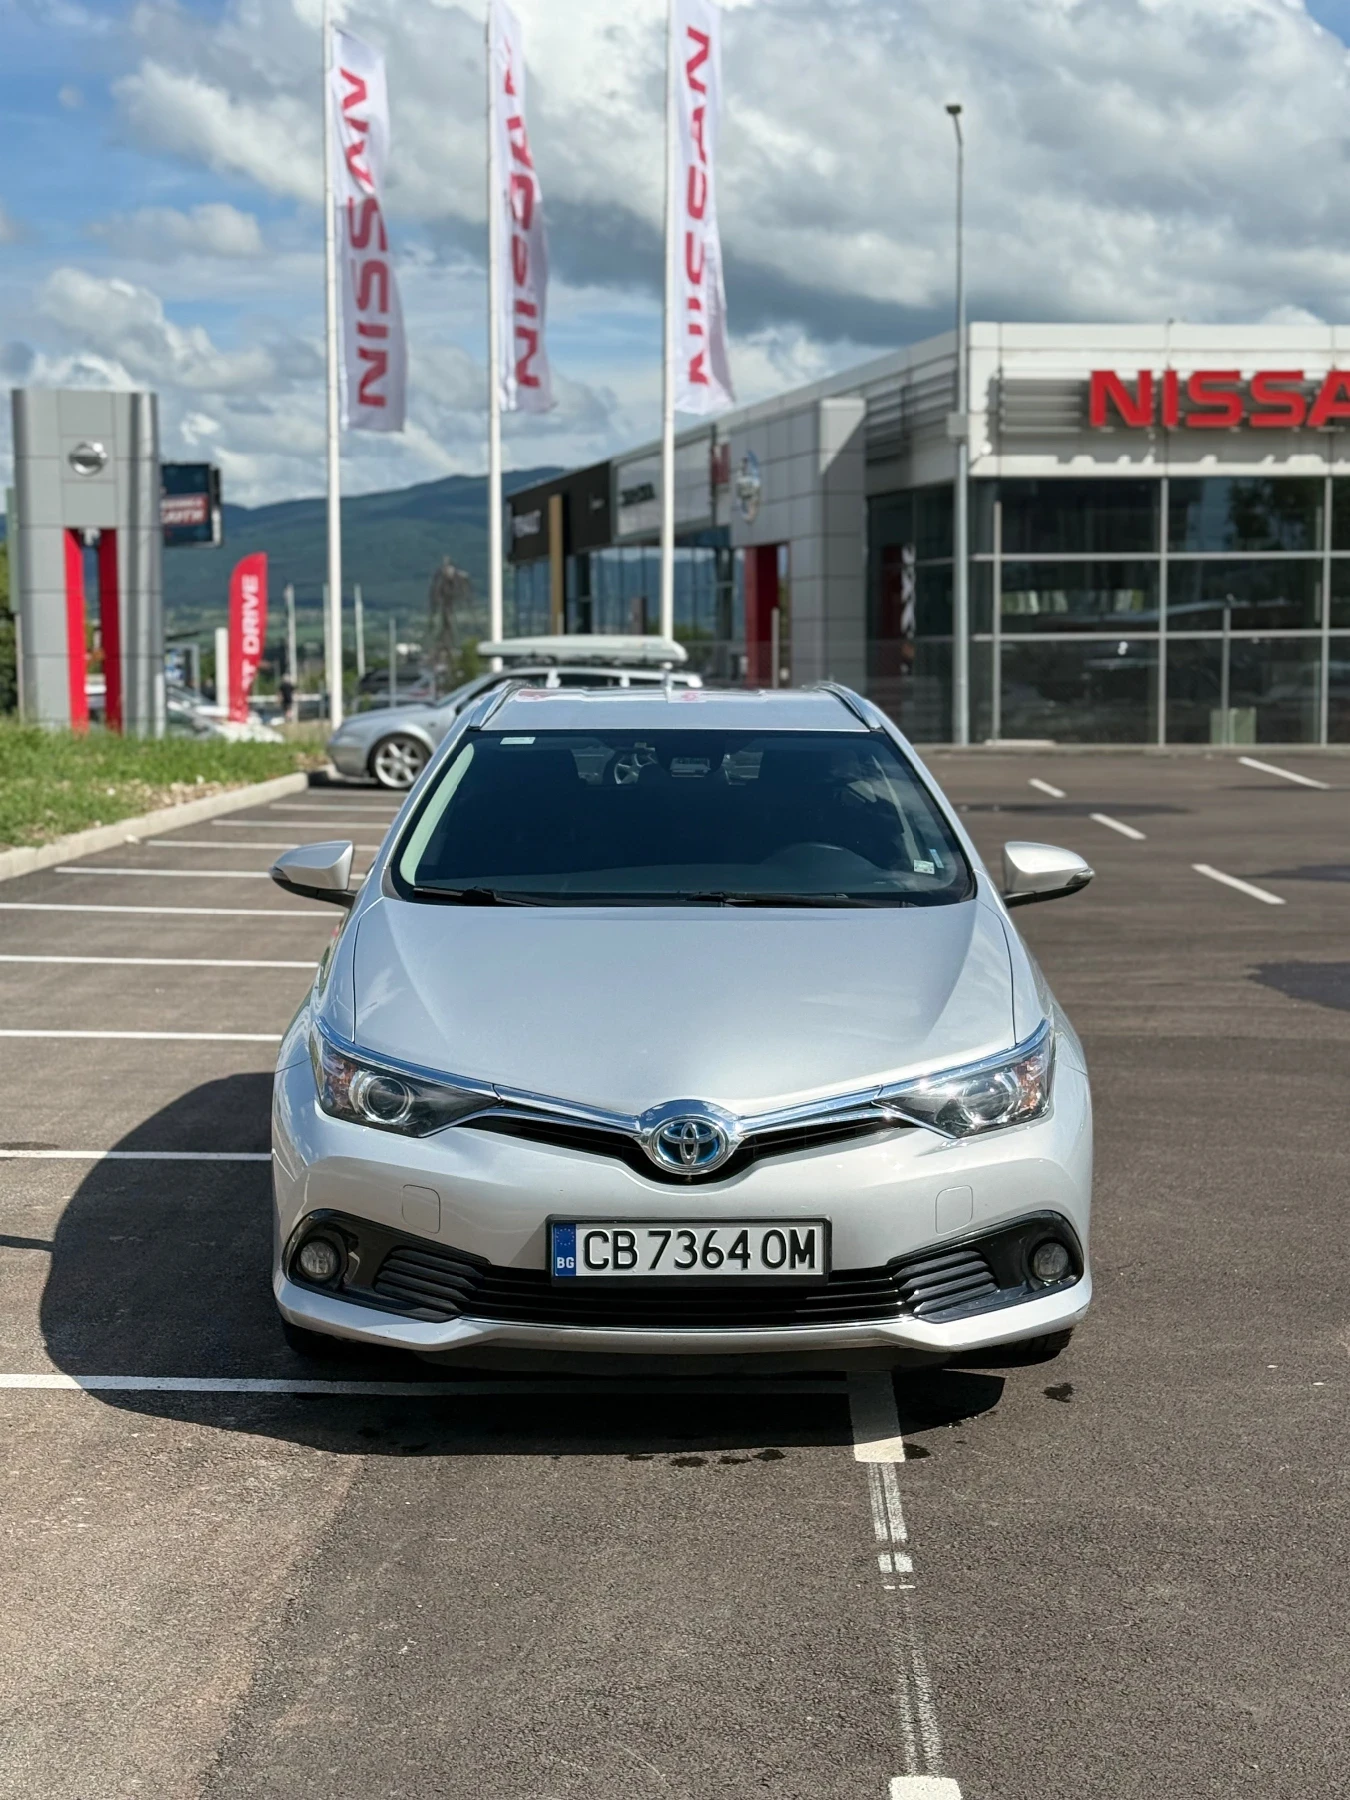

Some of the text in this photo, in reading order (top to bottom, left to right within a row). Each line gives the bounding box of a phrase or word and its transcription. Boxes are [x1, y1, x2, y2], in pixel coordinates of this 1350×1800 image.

[1089, 369, 1350, 427] NISSA
[241, 574, 260, 655] DRIVE
[556, 1257, 575, 1269] BG
[583, 1229, 639, 1270] CB
[647, 1229, 752, 1270] 7364
